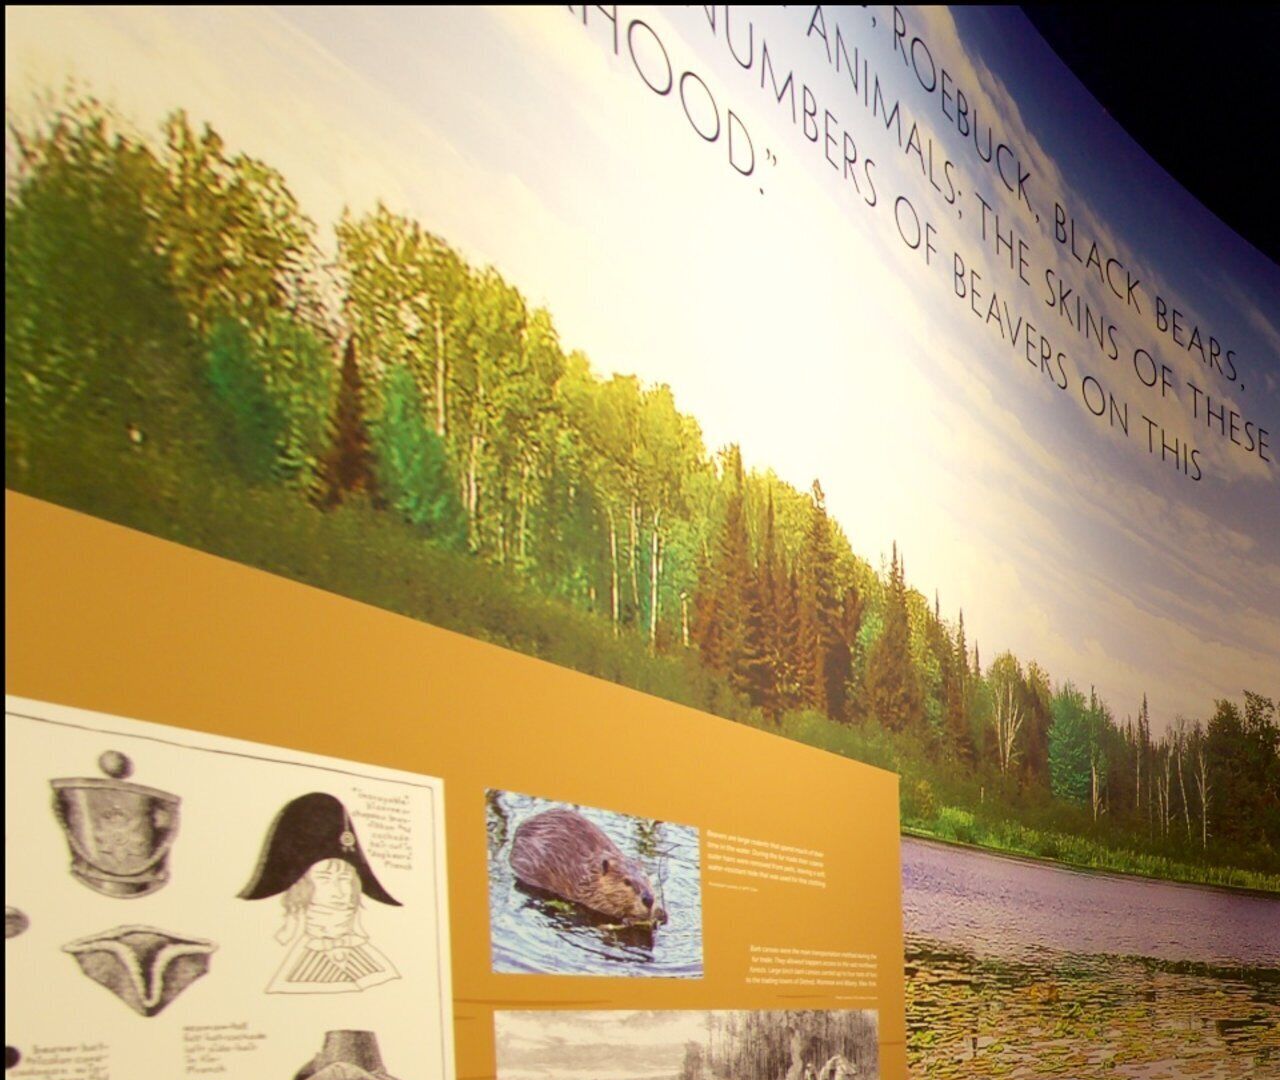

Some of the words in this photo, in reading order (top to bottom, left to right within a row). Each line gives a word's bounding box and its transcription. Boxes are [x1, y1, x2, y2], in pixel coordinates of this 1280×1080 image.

[806, 6, 963, 221] ANIMALS;
[974, 192, 1031, 287] THE
[1045, 268, 1119, 361] SKINS
[1133, 348, 1174, 398] OF
[1187, 380, 1270, 463] THESE
[893, 6, 1040, 224] ROEBUCK,
[1055, 203, 1141, 314] BLACK
[1155, 295, 1246, 391] BEARS,
[894, 195, 938, 266] OF
[953, 252, 1068, 391] BEAVERS
[1081, 375, 1129, 437] ON
[1142, 415, 1203, 482] THIS
